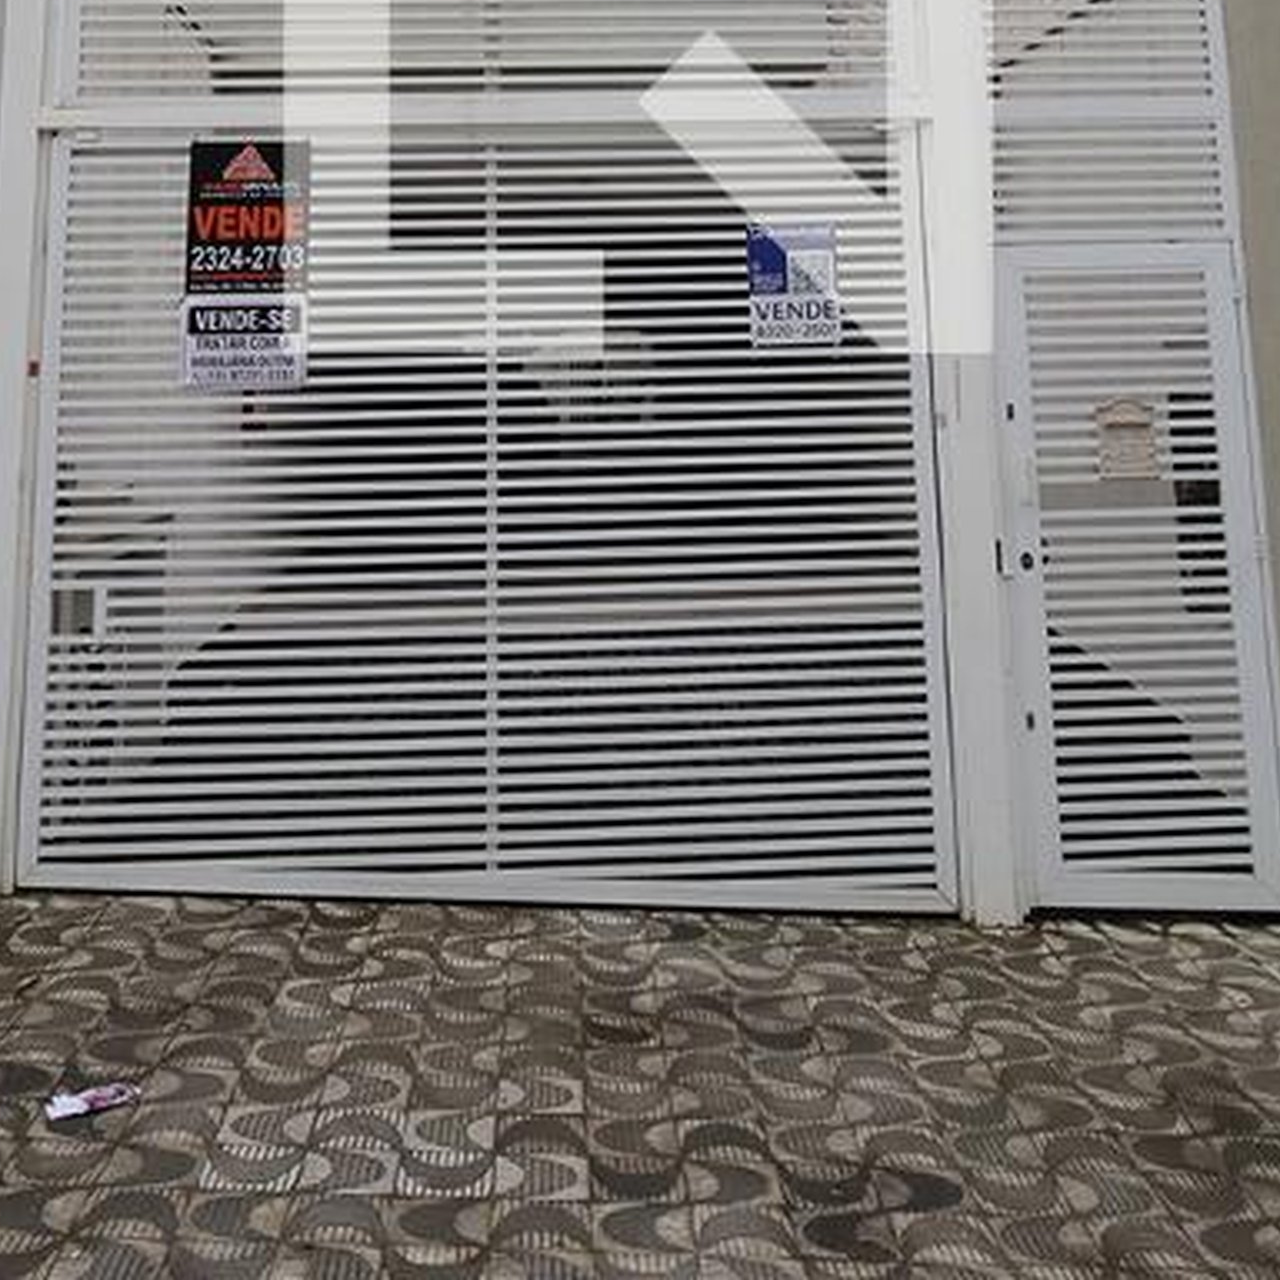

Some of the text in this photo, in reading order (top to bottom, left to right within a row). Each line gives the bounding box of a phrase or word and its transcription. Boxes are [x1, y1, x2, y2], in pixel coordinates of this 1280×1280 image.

[193, 205, 304, 240] VENDE
[195, 308, 295, 332] VENDE-SE
[753, 299, 838, 321] VENDE
